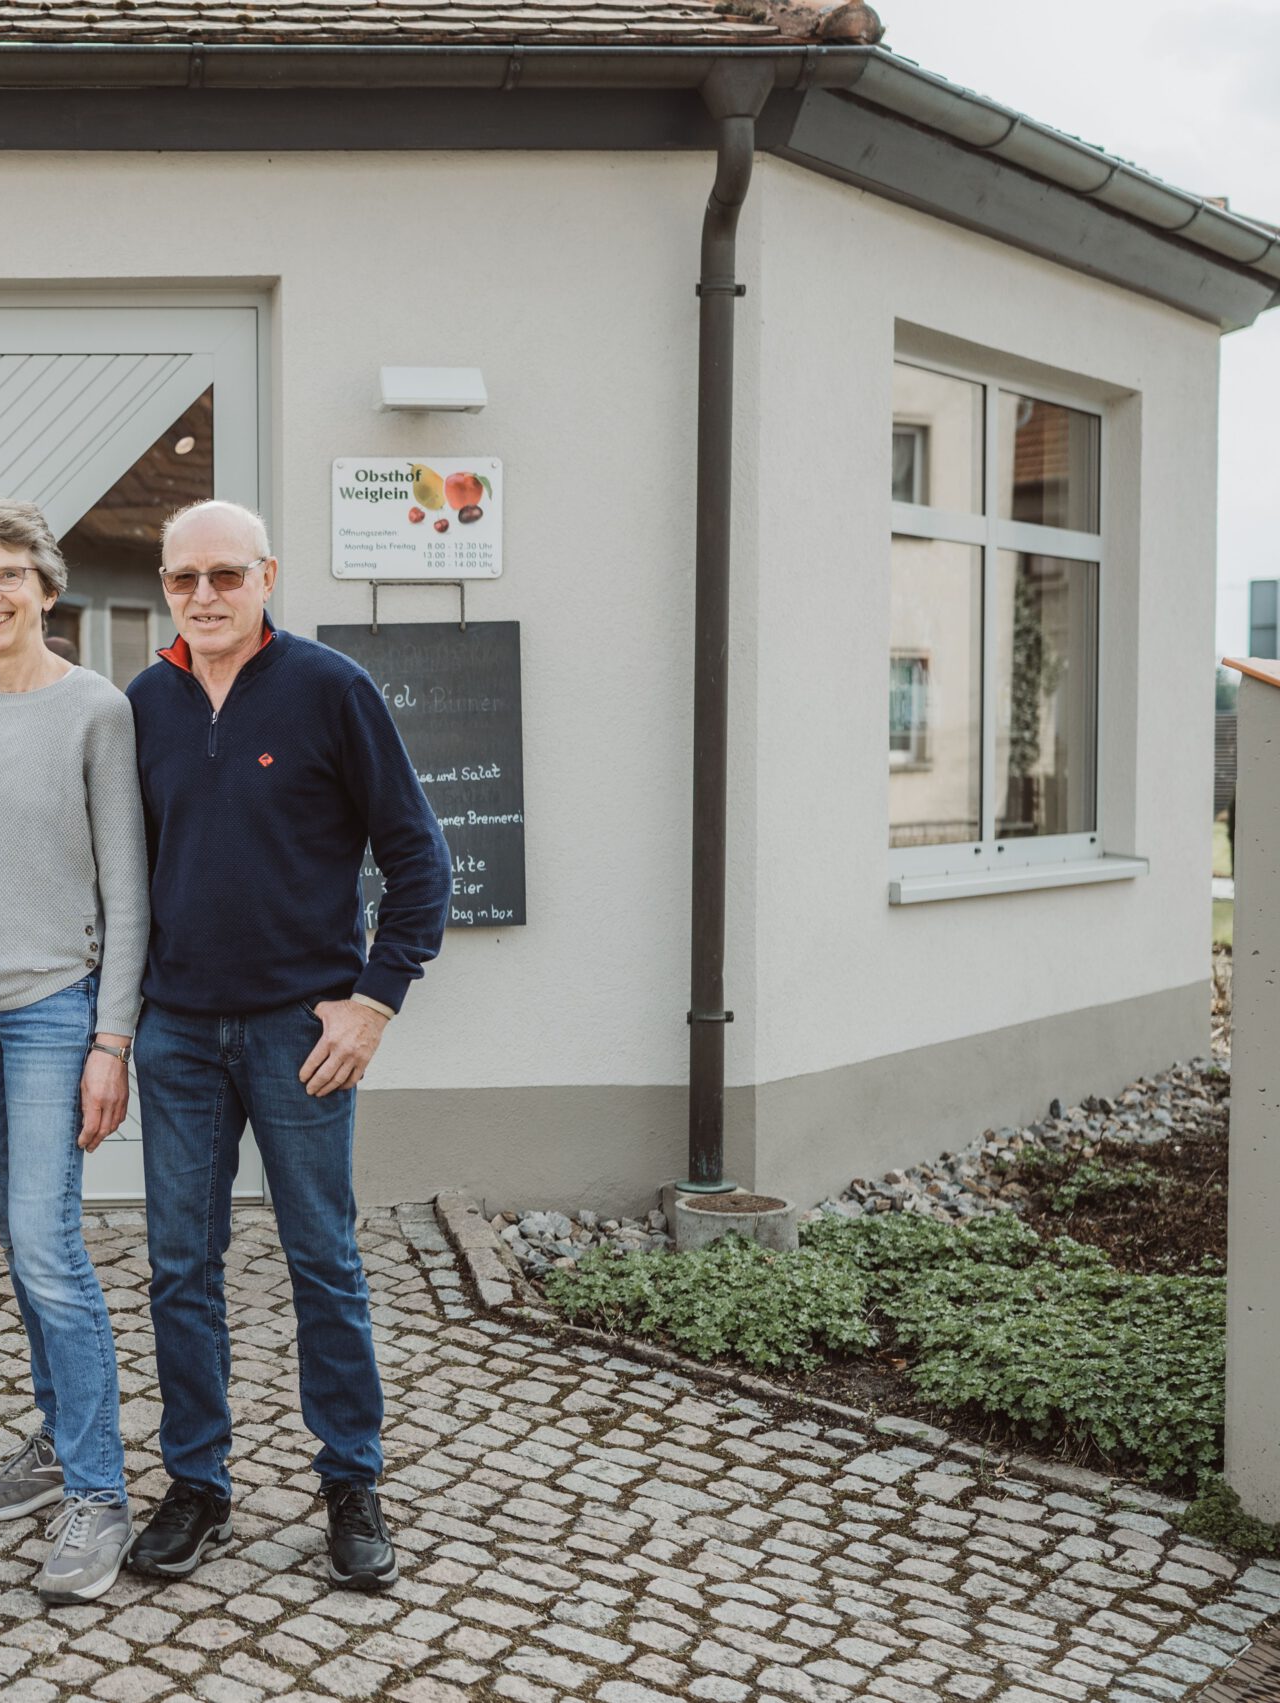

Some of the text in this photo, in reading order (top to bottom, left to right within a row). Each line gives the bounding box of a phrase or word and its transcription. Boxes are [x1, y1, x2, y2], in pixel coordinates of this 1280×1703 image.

[355, 469, 422, 482] Obsthof
[339, 487, 409, 503] Weiglein
[344, 543, 374, 551] Montag
[389, 543, 416, 551] Freitag
[479, 542, 493, 550] Uhr
[479, 551, 493, 559] Uhr
[344, 560, 377, 569] Samstag
[479, 560, 493, 568] Uhr
[382, 683, 417, 708] fel
[436, 767, 458, 782] und
[461, 763, 501, 781] Salat
[438, 809, 524, 832] gener Brennerei
[452, 877, 484, 895] Eier
[451, 904, 513, 925] bag in box
